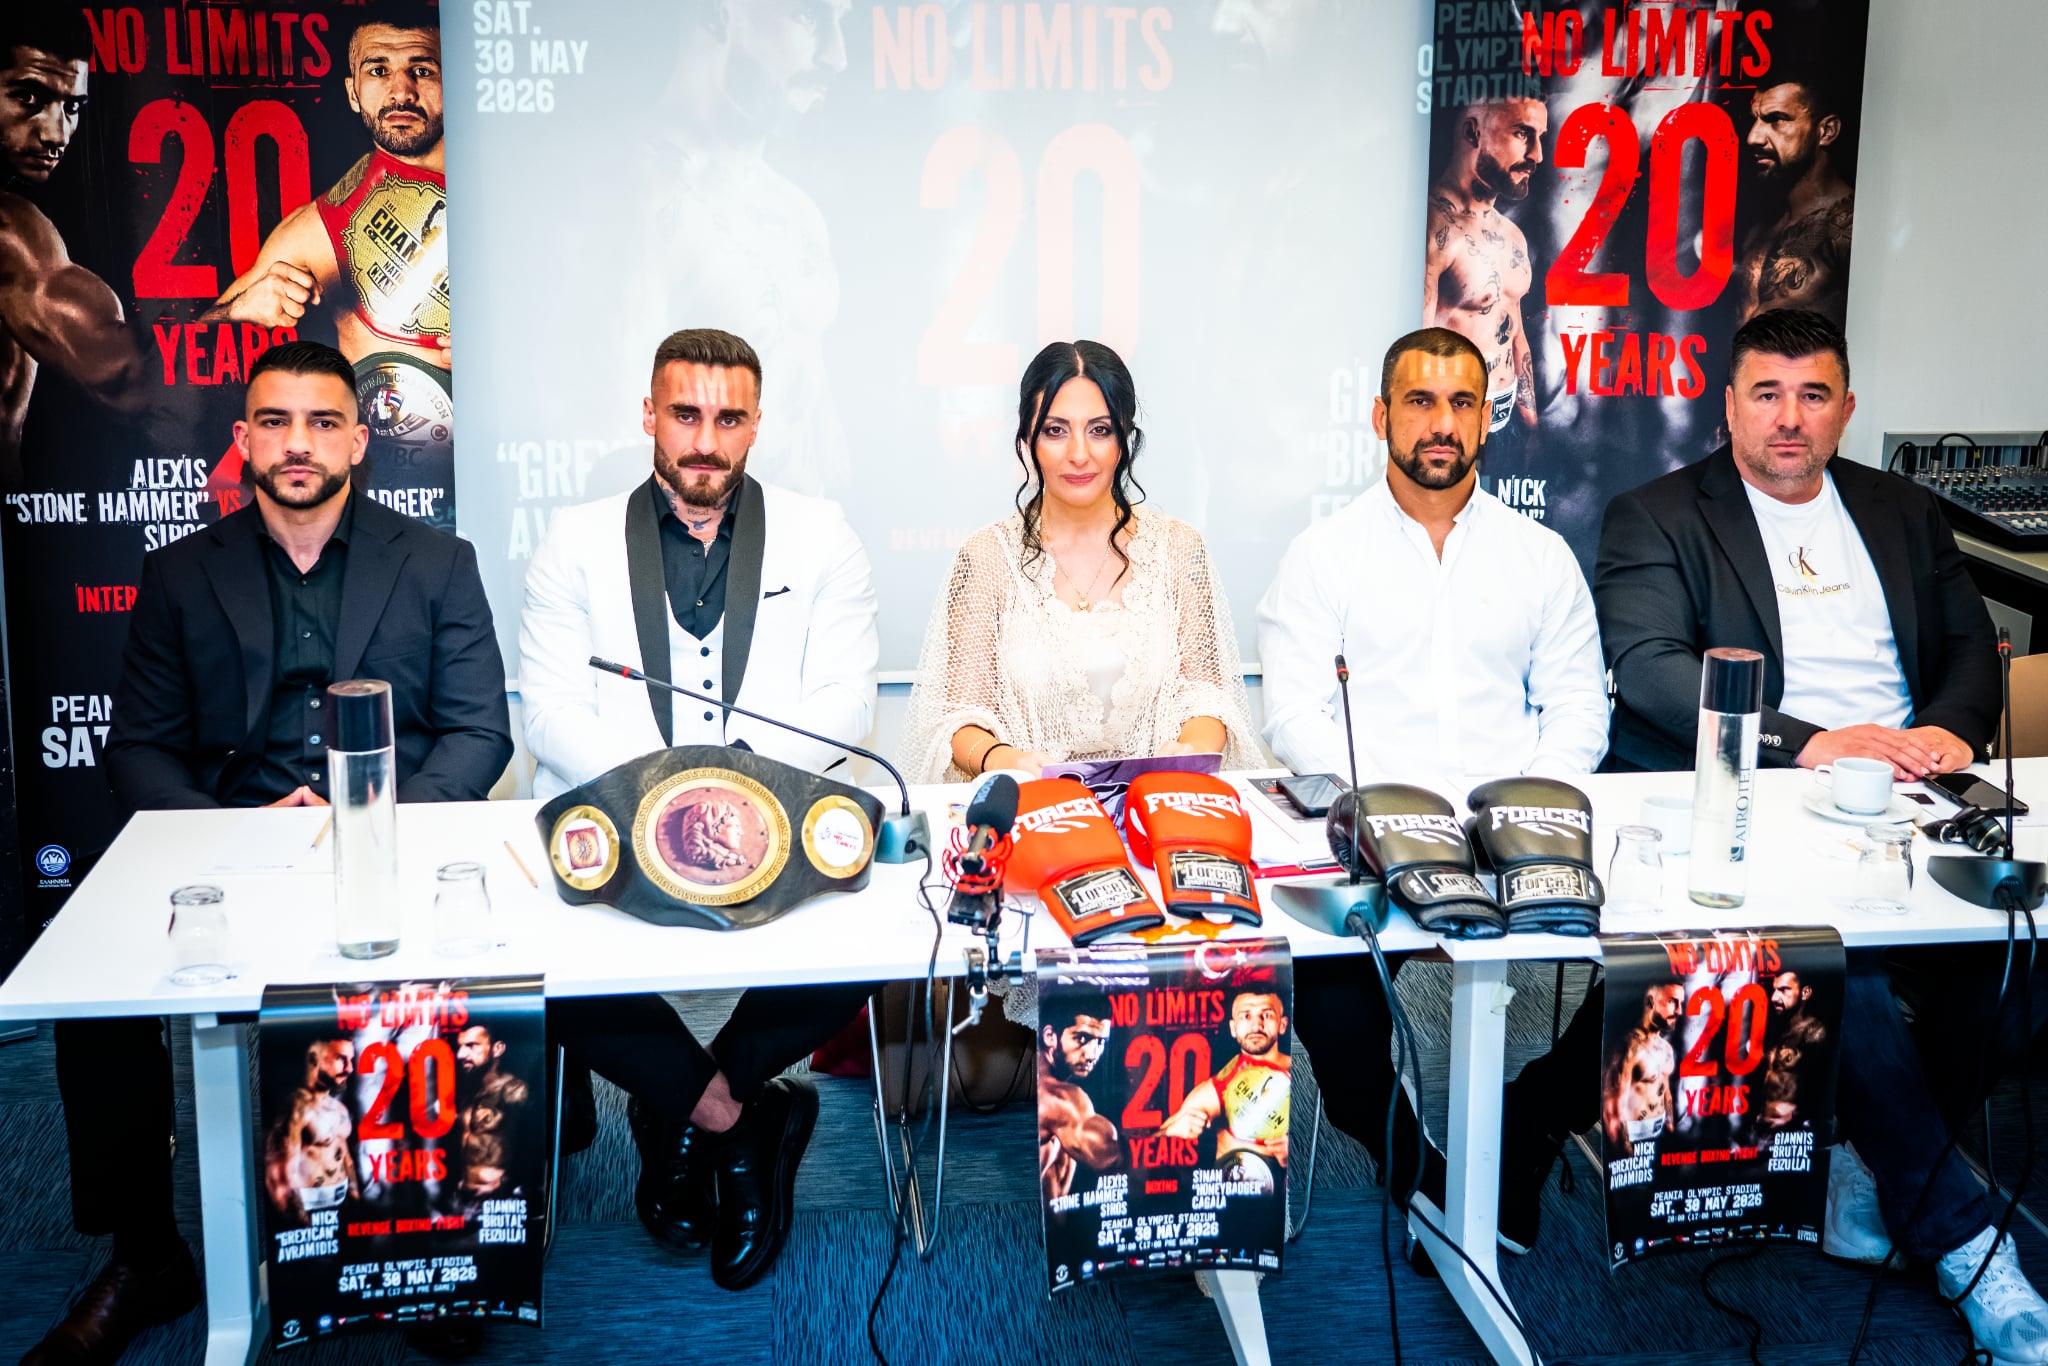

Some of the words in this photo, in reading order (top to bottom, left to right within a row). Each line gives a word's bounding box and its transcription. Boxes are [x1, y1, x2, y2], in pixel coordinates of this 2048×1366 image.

[473, 1, 541, 35] SAT.
[89, 7, 144, 75] NO
[166, 7, 333, 78] LIMITS
[475, 40, 516, 75] 30
[530, 40, 589, 74] MAY
[873, 6, 950, 90] NO
[971, 5, 1174, 92] LIMITS
[1522, 9, 1584, 77] NO
[1601, 9, 1773, 78] LIMITS
[476, 79, 556, 113] 2026
[128, 98, 313, 299] 20
[1544, 101, 1740, 311] 20
[918, 123, 1141, 386] 20
[1560, 333, 1707, 398] YEARS
[132, 457, 208, 489] ALEXIS
[217, 490, 242, 517] VS
[1498, 477, 1546, 506] NICK
[1820, 582, 1850, 594] Jeans
[1736, 761, 1751, 842] AIROTEL
[1667, 943, 1698, 976] NO
[1702, 939, 1782, 974] LIMITS
[336, 995, 372, 1030] NO
[380, 990, 469, 1028] LIMITS
[1109, 993, 1140, 1027] NO
[1146, 989, 1225, 1025] LIMITS
[1679, 983, 1769, 1078] 20
[357, 1038, 457, 1141] 20
[1122, 1033, 1212, 1129] 20
[1685, 1084, 1750, 1117] YEARS
[1129, 1135, 1199, 1169] YEARS
[1634, 1141, 1655, 1156] NICK
[1774, 1131, 1813, 1146] GIANNIS
[369, 1148, 447, 1184] YEARS
[1097, 1173, 1128, 1190] ALEXIS
[1610, 1169, 1653, 1191] AVRAMIDIS
[483, 1199, 527, 1214] GIANNIS
[1650, 1201, 1675, 1217] SAT.
[1684, 1198, 1700, 1212] 30
[1705, 1195, 1727, 1211] MAY
[1733, 1193, 1763, 1207] 2026
[1654, 1190, 1683, 1202] PEANIA
[1687, 1187, 1722, 1199] OLYMPIC
[1726, 1183, 1760, 1195] STADIUM
[311, 1210, 339, 1227] NICK
[1101, 1218, 1133, 1230] PEANIA
[1137, 1214, 1174, 1227] OLYMPIC
[1178, 1212, 1216, 1224] STADIUM
[1135, 1226, 1152, 1242] 30
[1156, 1224, 1181, 1240] MAY
[1186, 1221, 1219, 1237] 2026
[278, 1240, 339, 1264] AVRAMIDIS
[342, 1262, 380, 1276] PEANIA
[384, 1258, 427, 1272] OLYMPIC
[431, 1255, 474, 1268] STADIUM
[338, 1275, 372, 1293] SAT.
[382, 1272, 402, 1287] 30
[407, 1269, 435, 1285] MAY
[441, 1266, 478, 1282] 2026
